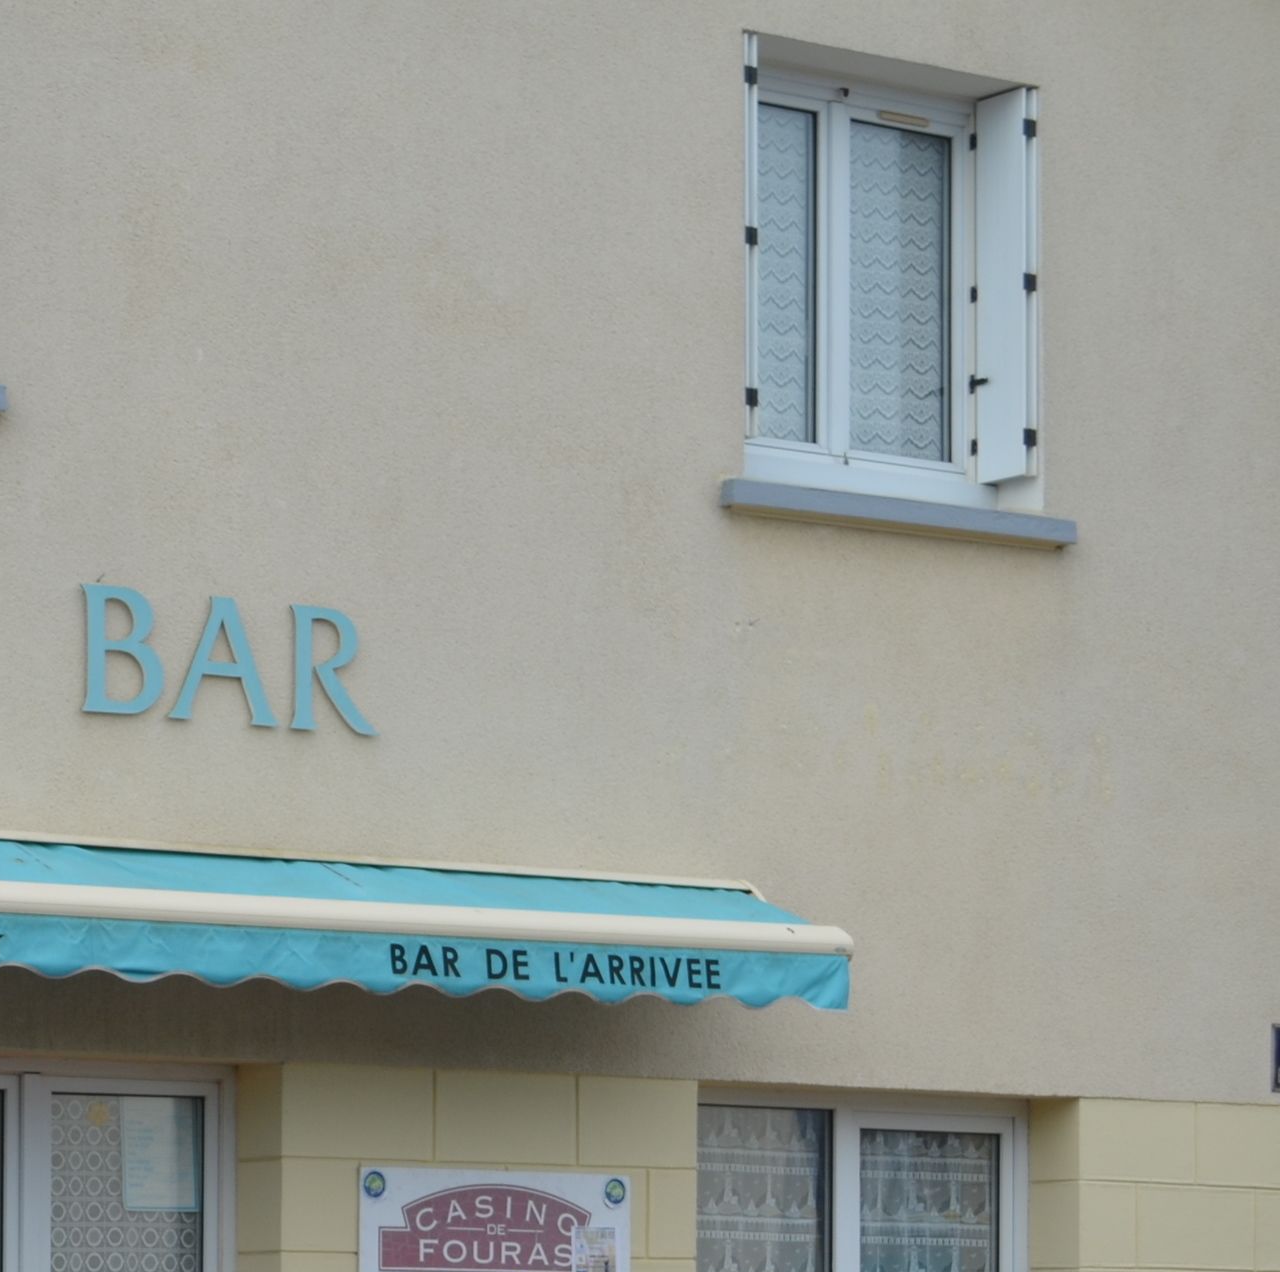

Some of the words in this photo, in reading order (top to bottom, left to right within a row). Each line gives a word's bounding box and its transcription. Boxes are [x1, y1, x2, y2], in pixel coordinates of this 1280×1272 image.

[80, 581, 378, 736] BAR
[390, 943, 461, 978] BAR
[486, 948, 530, 981] DE
[554, 951, 722, 990] L'ARRIVEE
[415, 1195, 578, 1236] CASINO
[487, 1224, 506, 1236] DE
[418, 1239, 572, 1267] FOURAS
